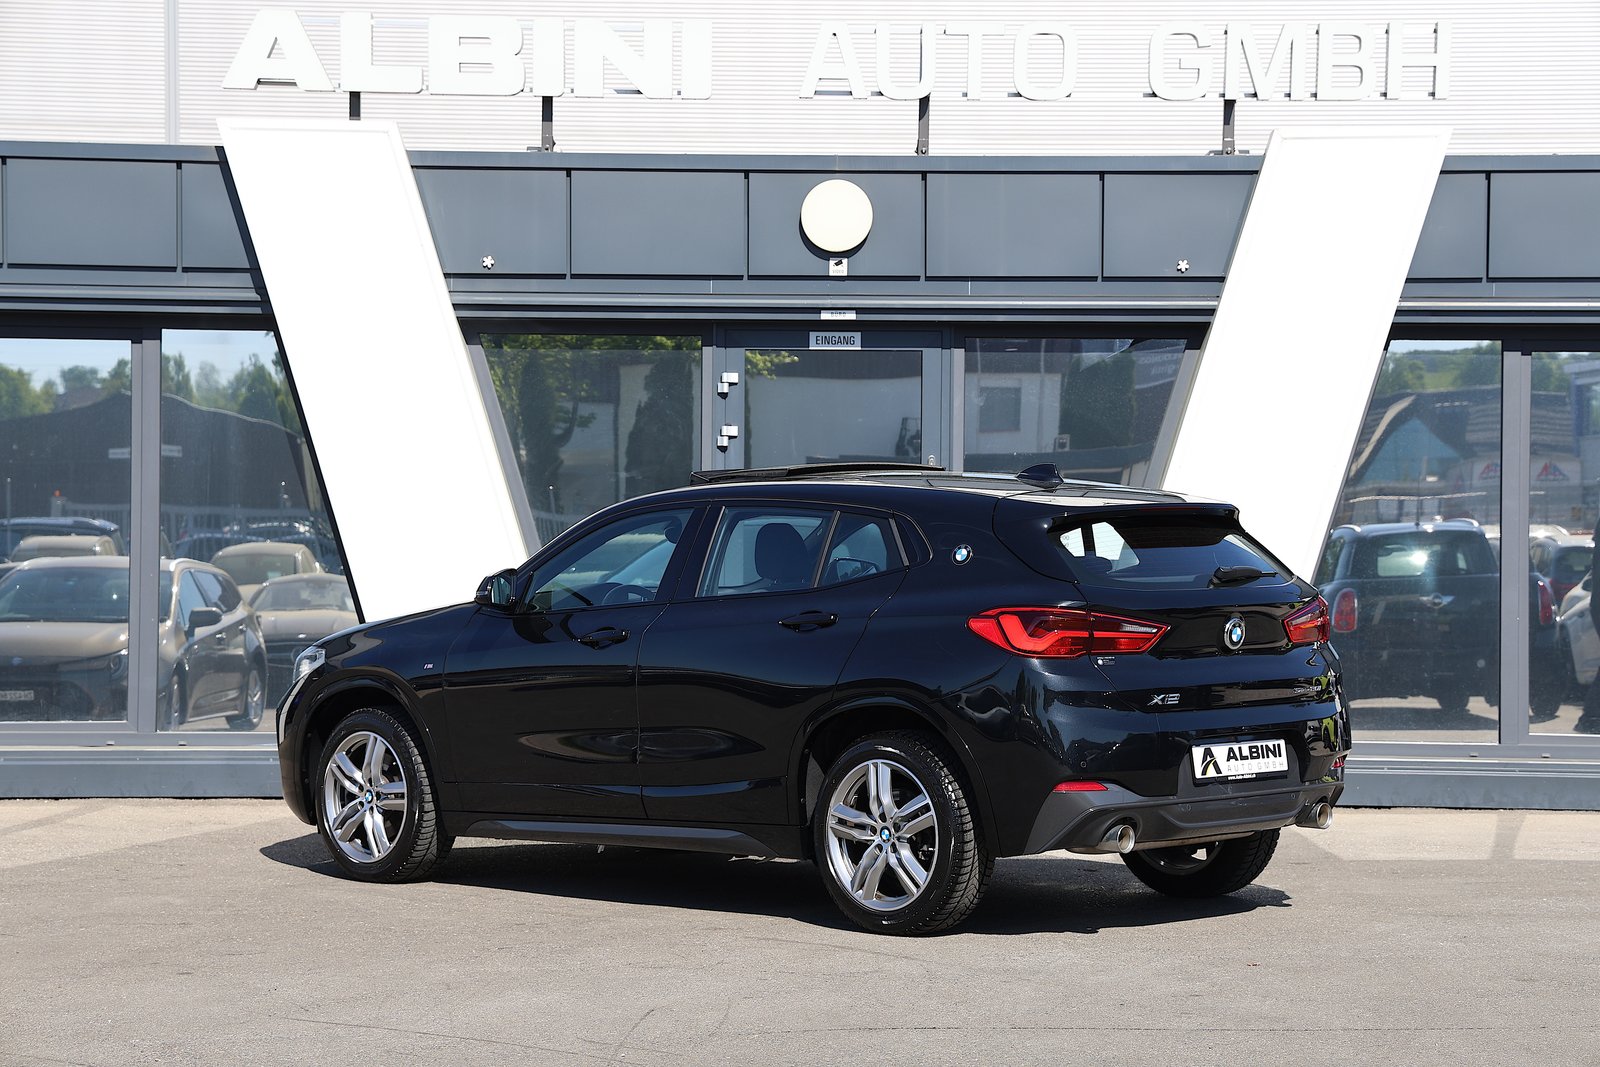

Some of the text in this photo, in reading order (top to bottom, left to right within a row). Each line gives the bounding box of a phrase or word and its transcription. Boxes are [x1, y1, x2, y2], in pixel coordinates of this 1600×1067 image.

[222, 10, 1451, 101] ALBINI AUTO GMBH
[816, 335, 855, 345] EINGANG
[1147, 693, 1181, 705] X2
[1226, 743, 1282, 762] ALBINI
[1228, 761, 1284, 772] AUTO GMBH
